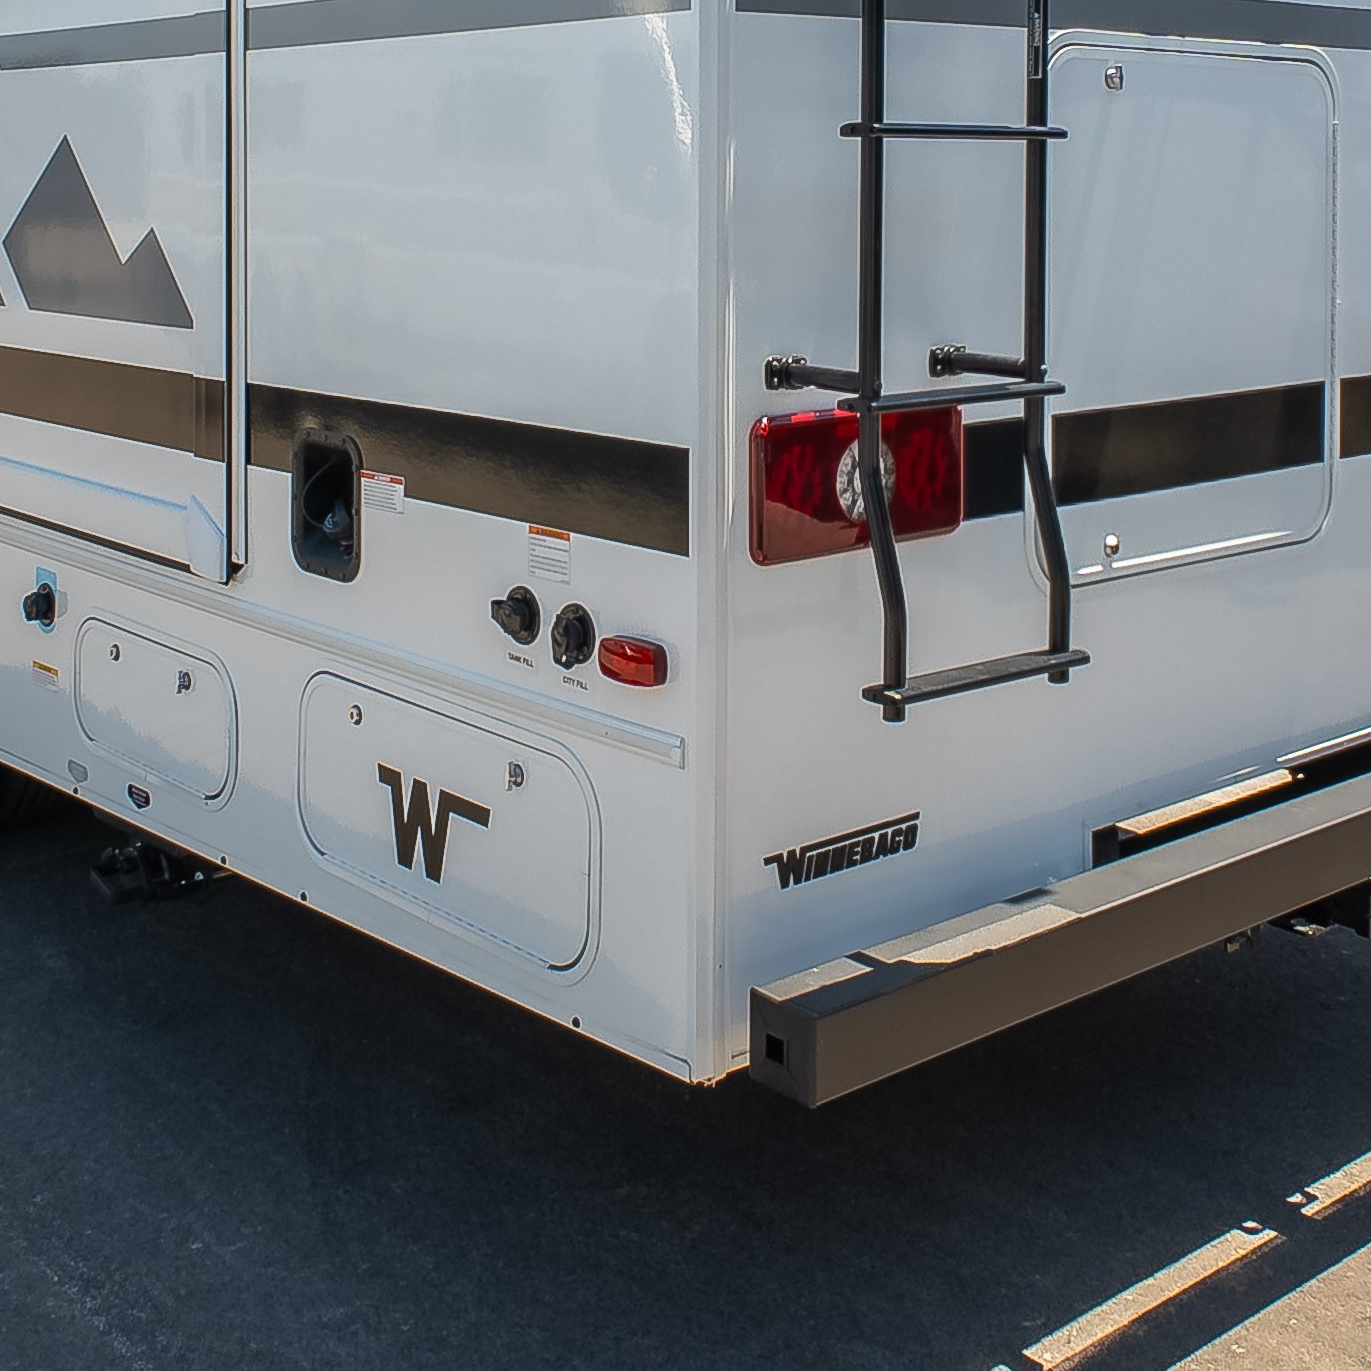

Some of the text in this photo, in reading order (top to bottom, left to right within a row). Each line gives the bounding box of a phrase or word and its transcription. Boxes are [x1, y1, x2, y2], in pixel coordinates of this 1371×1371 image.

[522, 657, 534, 668] FILL
[562, 675, 588, 691] CITY FILL
[762, 811, 921, 890] WINNEBAGO
